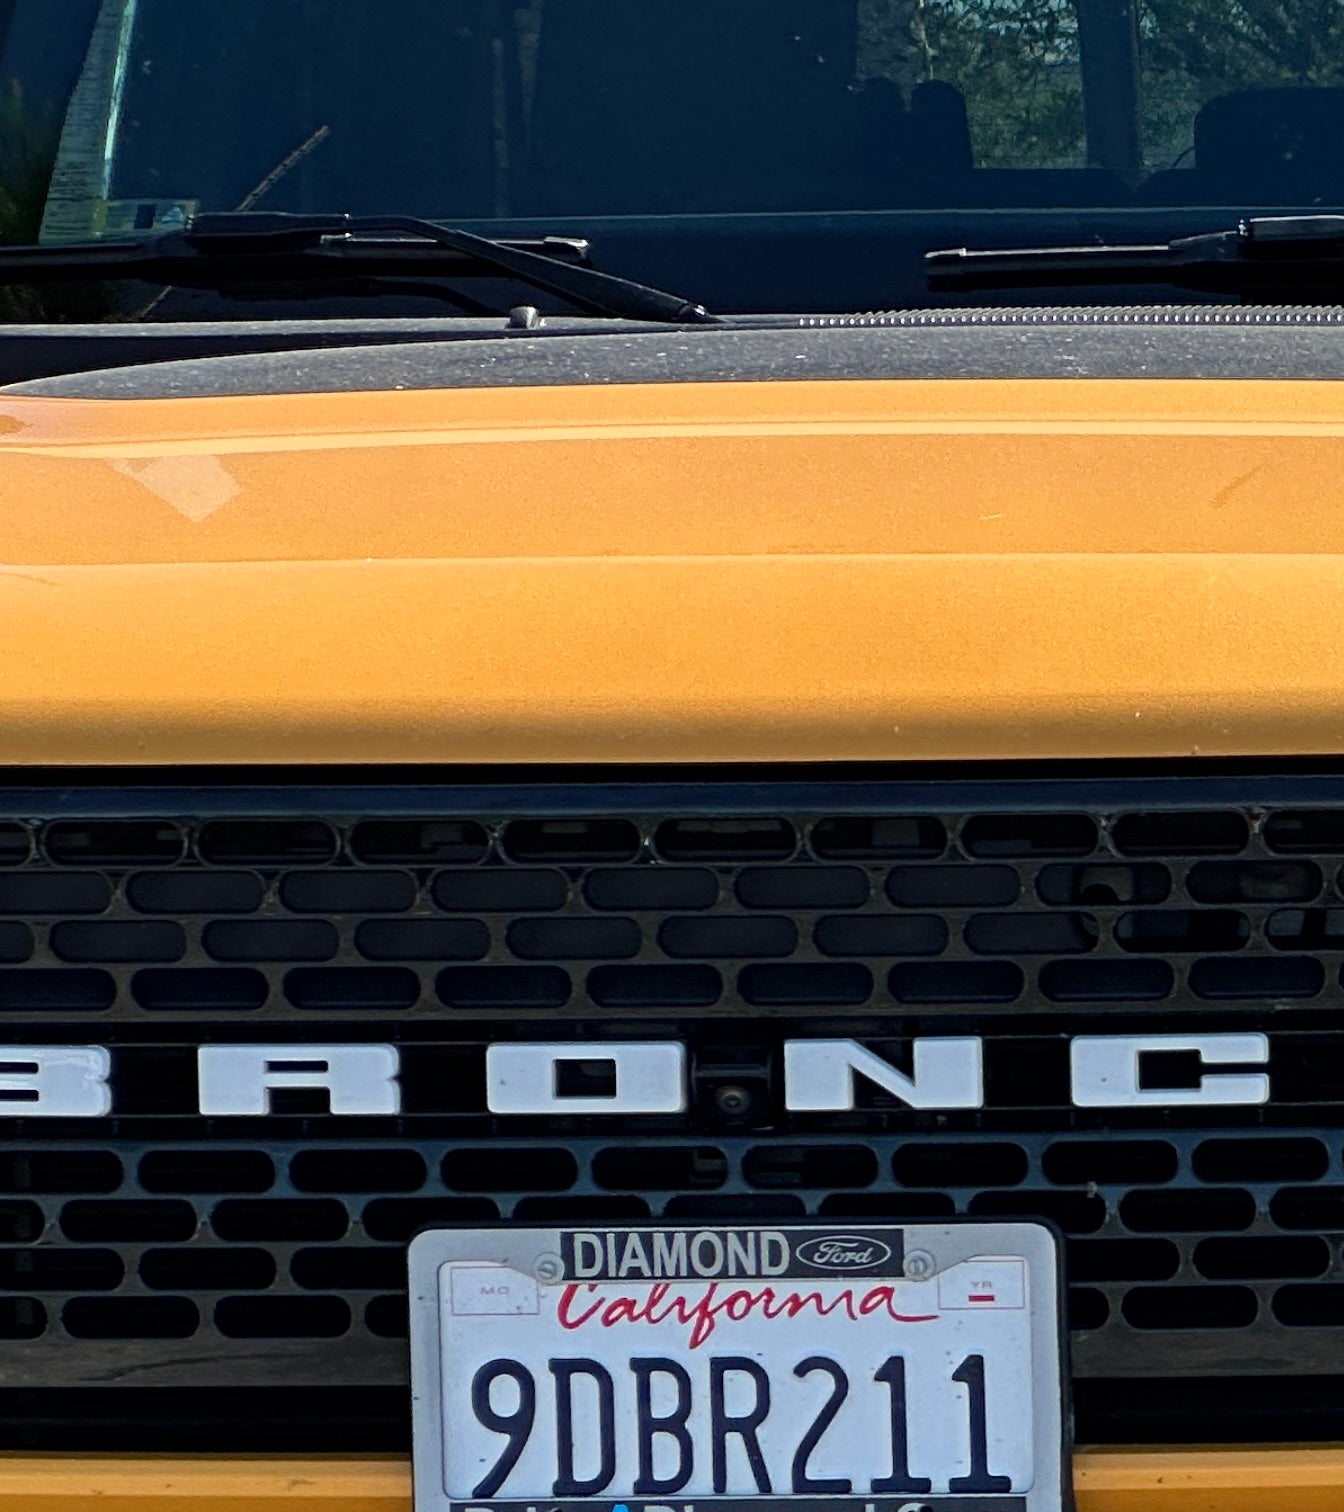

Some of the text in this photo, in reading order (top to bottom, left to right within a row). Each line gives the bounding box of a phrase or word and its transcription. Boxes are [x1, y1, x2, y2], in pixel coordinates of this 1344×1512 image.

[573, 1231, 874, 1278] DIAMOND Ford
[557, 1282, 939, 1349] California
[470, 1353, 1012, 1499] 9DBR211
